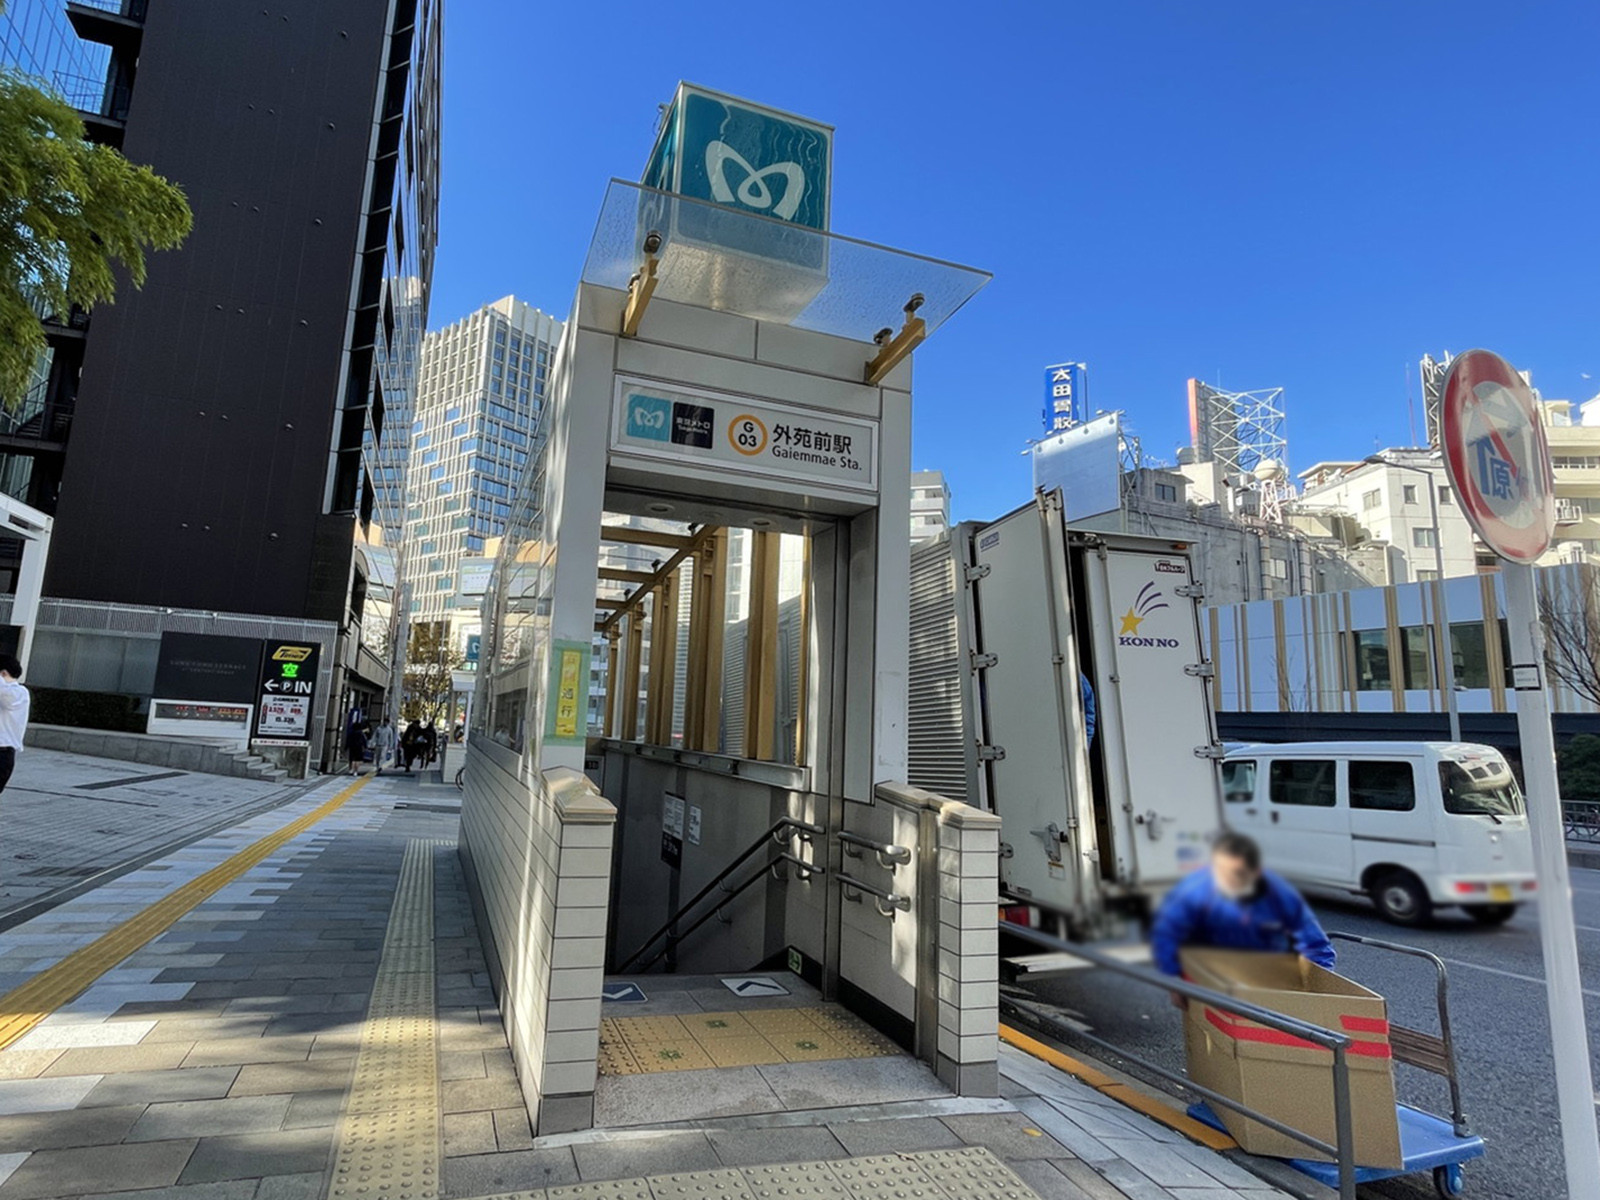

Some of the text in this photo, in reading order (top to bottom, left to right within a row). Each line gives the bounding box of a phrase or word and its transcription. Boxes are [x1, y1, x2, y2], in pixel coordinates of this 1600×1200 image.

[743, 421, 754, 433] G
[738, 434, 757, 447] 03
[772, 423, 852, 455] 外苑前駅
[772, 446, 862, 471] Gaiemmae Sta.
[294, 681, 312, 694] IN
